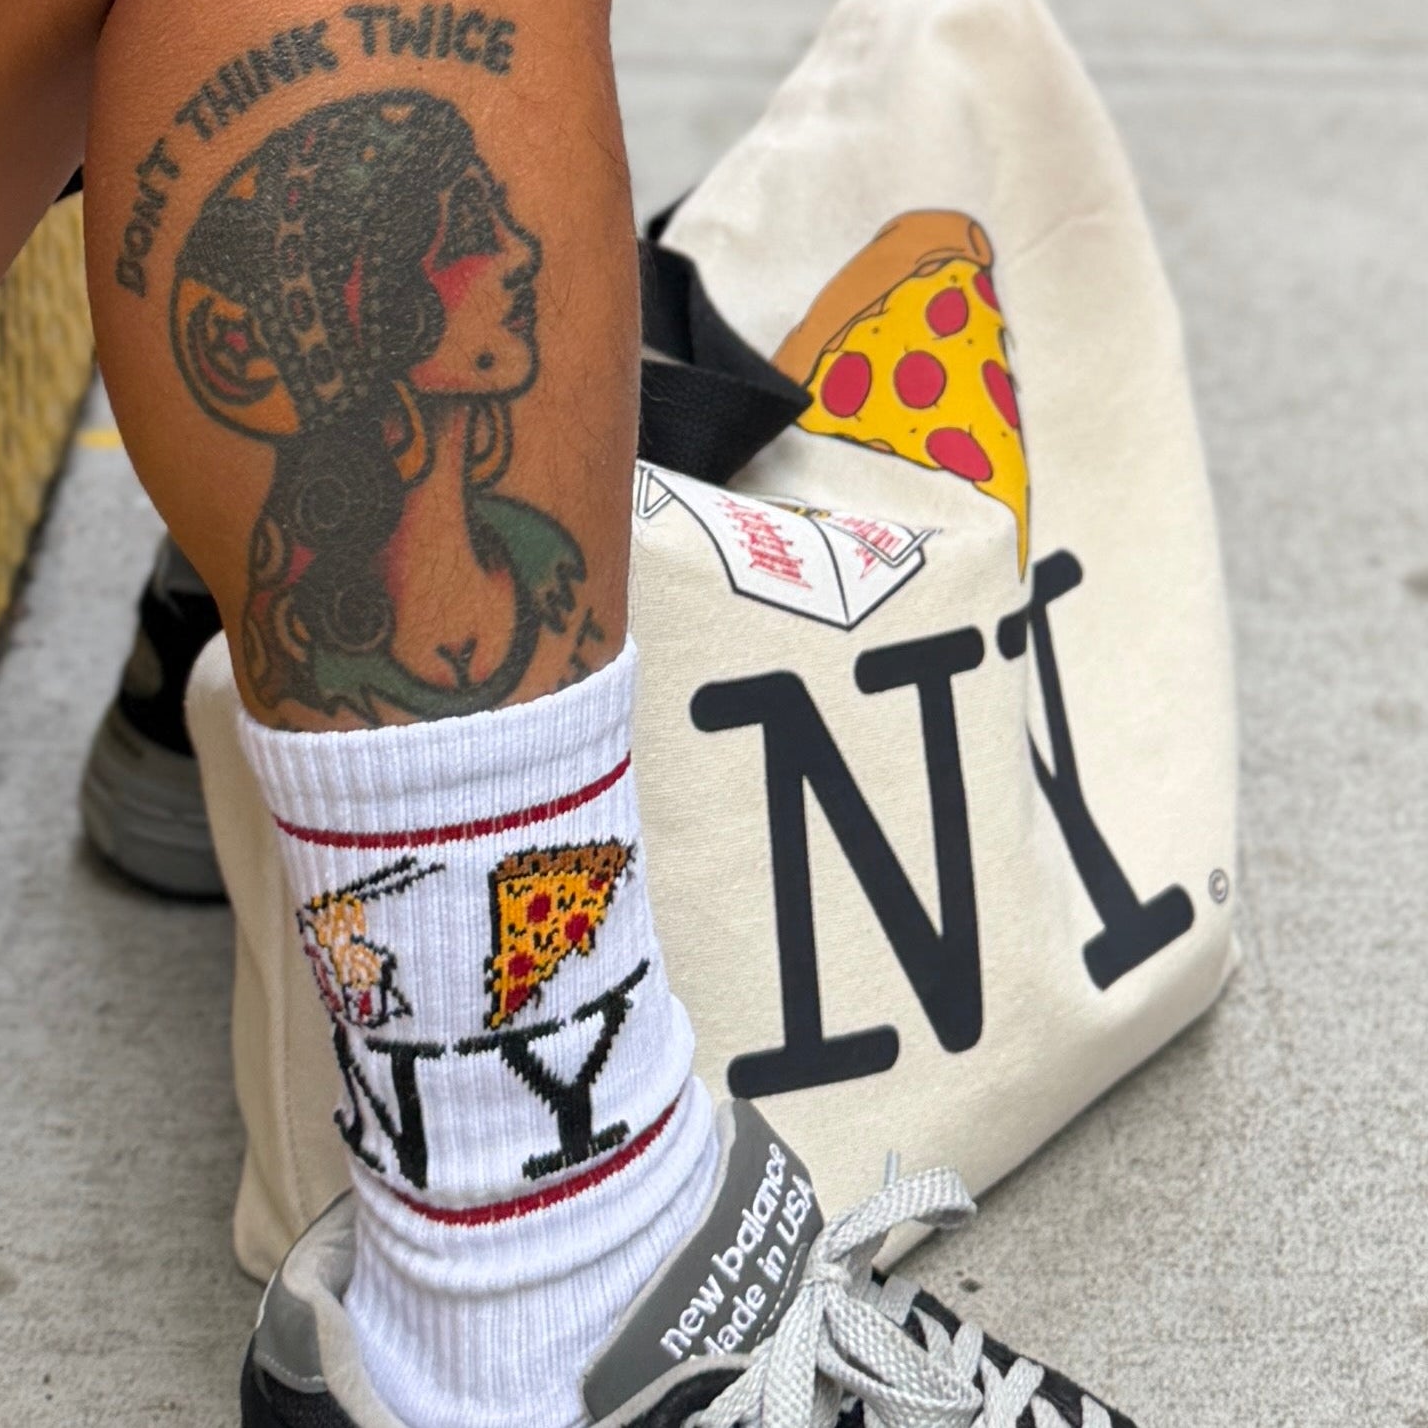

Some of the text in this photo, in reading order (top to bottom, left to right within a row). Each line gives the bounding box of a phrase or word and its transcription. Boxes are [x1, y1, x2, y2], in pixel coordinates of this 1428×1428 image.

[173, 19, 340, 142] THINK
[343, 1, 517, 77] TWICE
[333, 957, 651, 1189] NY
[660, 1143, 787, 1360] new balance
[755, 1245, 787, 1283] in
[776, 1174, 815, 1245] USA
